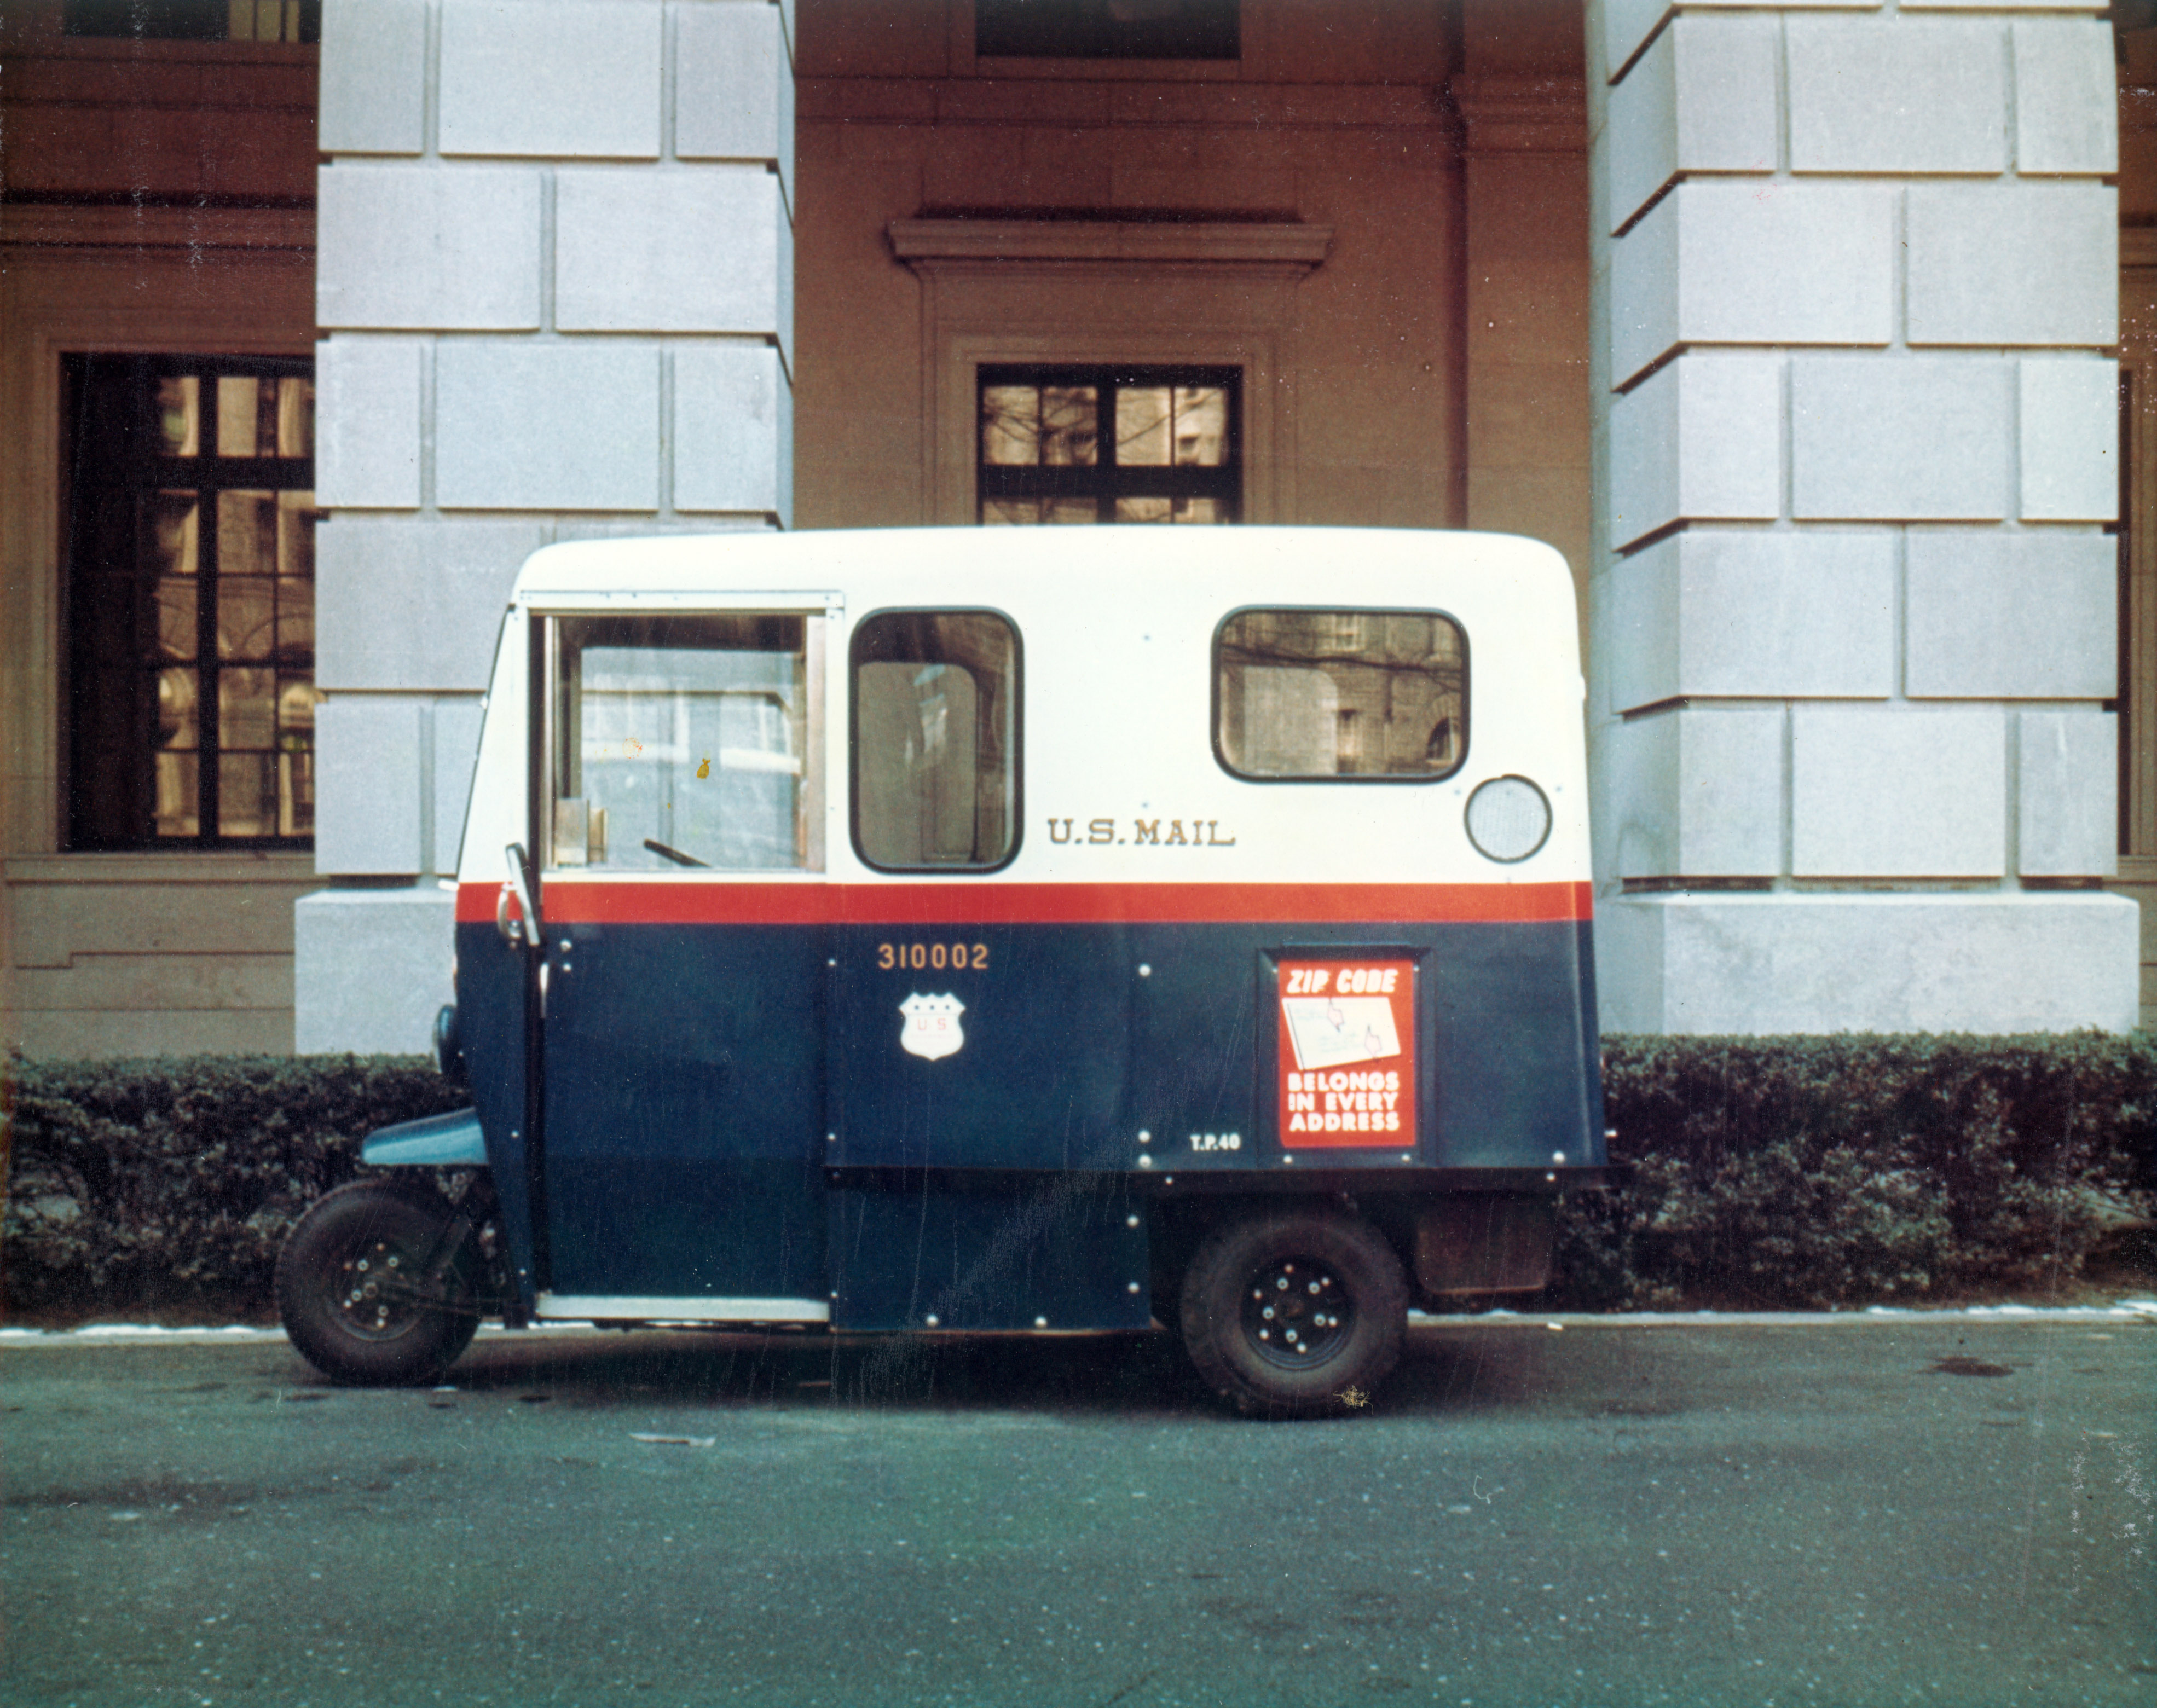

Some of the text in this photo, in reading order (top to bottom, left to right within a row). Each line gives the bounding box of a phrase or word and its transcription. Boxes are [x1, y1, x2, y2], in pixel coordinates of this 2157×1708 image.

[878, 943, 988, 969] 310002
[1287, 968, 1399, 993] ZIP CODE
[1288, 1071, 1400, 1092] BELONGS
[1288, 1092, 1398, 1111] IN EVERY
[1289, 1111, 1400, 1132] ADDRESS
